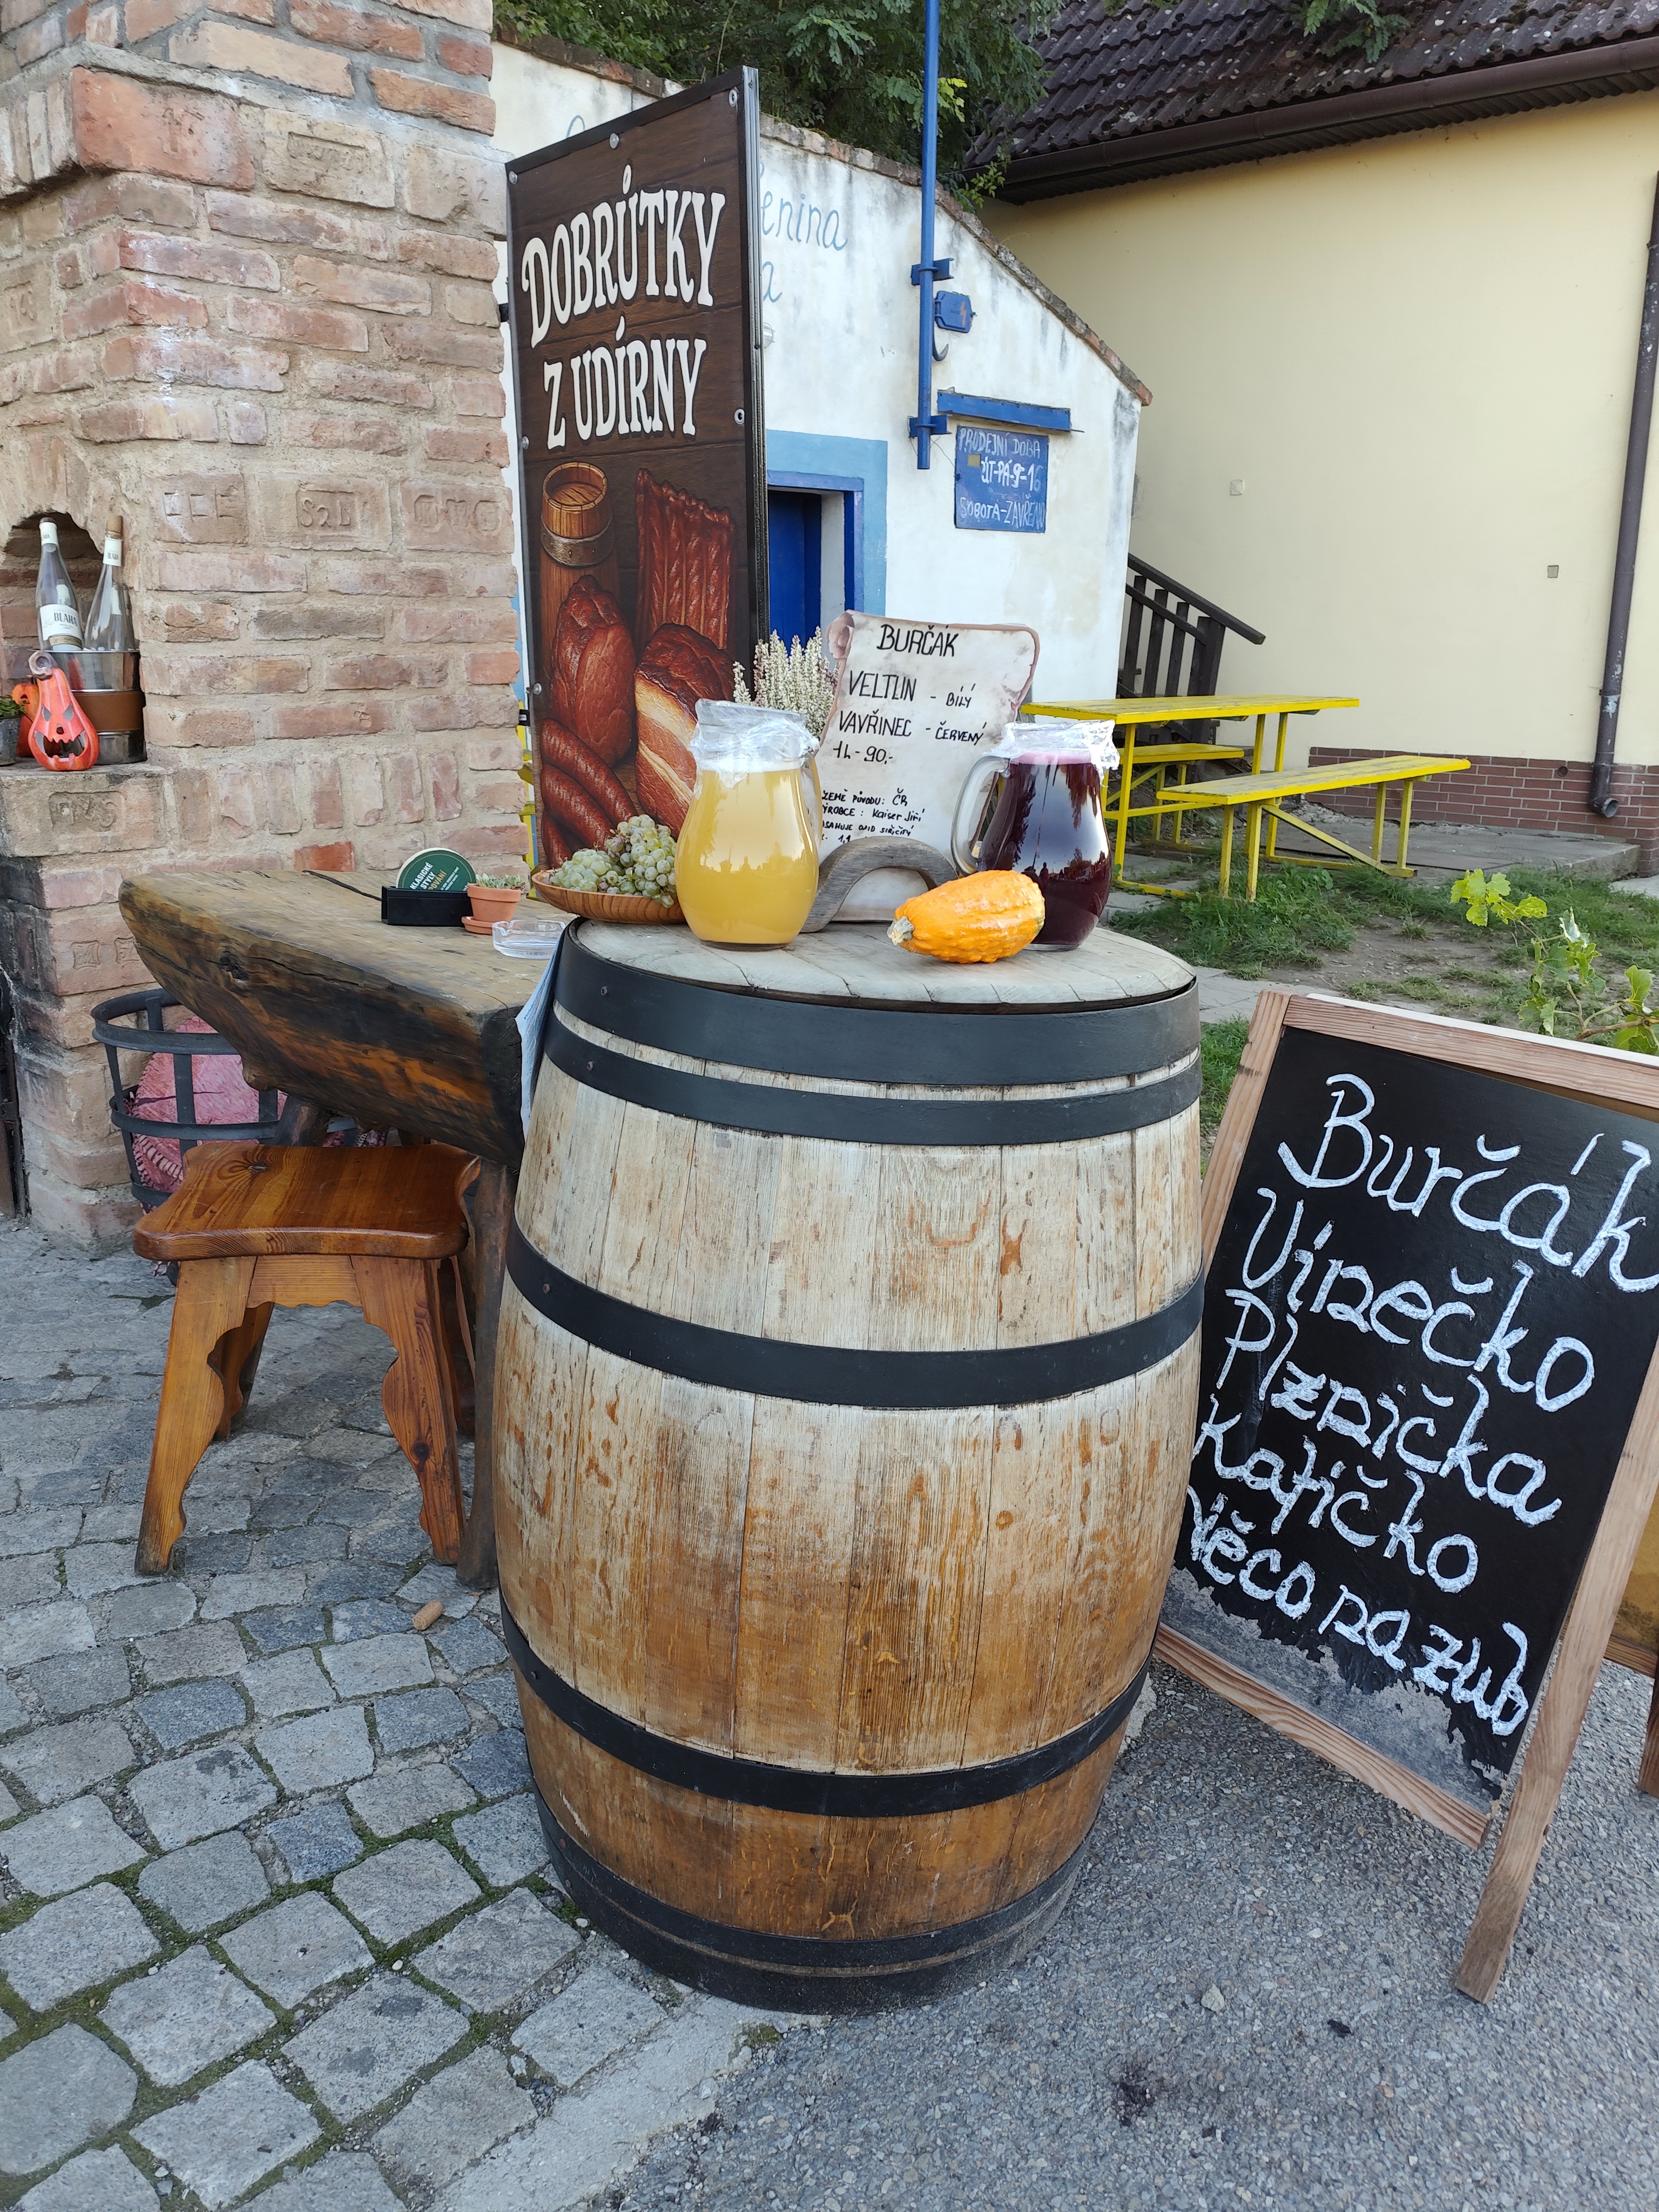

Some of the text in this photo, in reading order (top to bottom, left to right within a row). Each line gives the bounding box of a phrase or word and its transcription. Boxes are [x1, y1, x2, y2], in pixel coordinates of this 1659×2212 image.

[760, 191, 848, 251] enina
[544, 315, 707, 449] Z UDÍRNY
[1012, 438, 1041, 459] DOBA
[53, 612, 78, 626] BLAHA
[876, 624, 959, 657] BURČÁK
[849, 670, 917, 702] VELTLIN
[946, 683, 976, 708] BÍLÝ
[838, 709, 912, 737] VAVŘINEC
[935, 721, 987, 746] ČERVENÝ
[821, 788, 908, 806] ZEMĚ PŮVODU: ČR
[822, 802, 856, 817] ÝROBCE
[872, 808, 902, 821] Kaiser
[903, 808, 925, 821] Jiří
[822, 820, 853, 831] SAHUJE
[858, 824, 875, 832] OXID
[409, 861, 433, 890] KLASICKÉ
[420, 871, 436, 890] STYLY
[427, 869, 447, 891] POVÁNÍ
[1277, 1073, 1659, 1292] Burčák
[1318, 1584, 1411, 1671] na
[1413, 1622, 1529, 1736] zub
